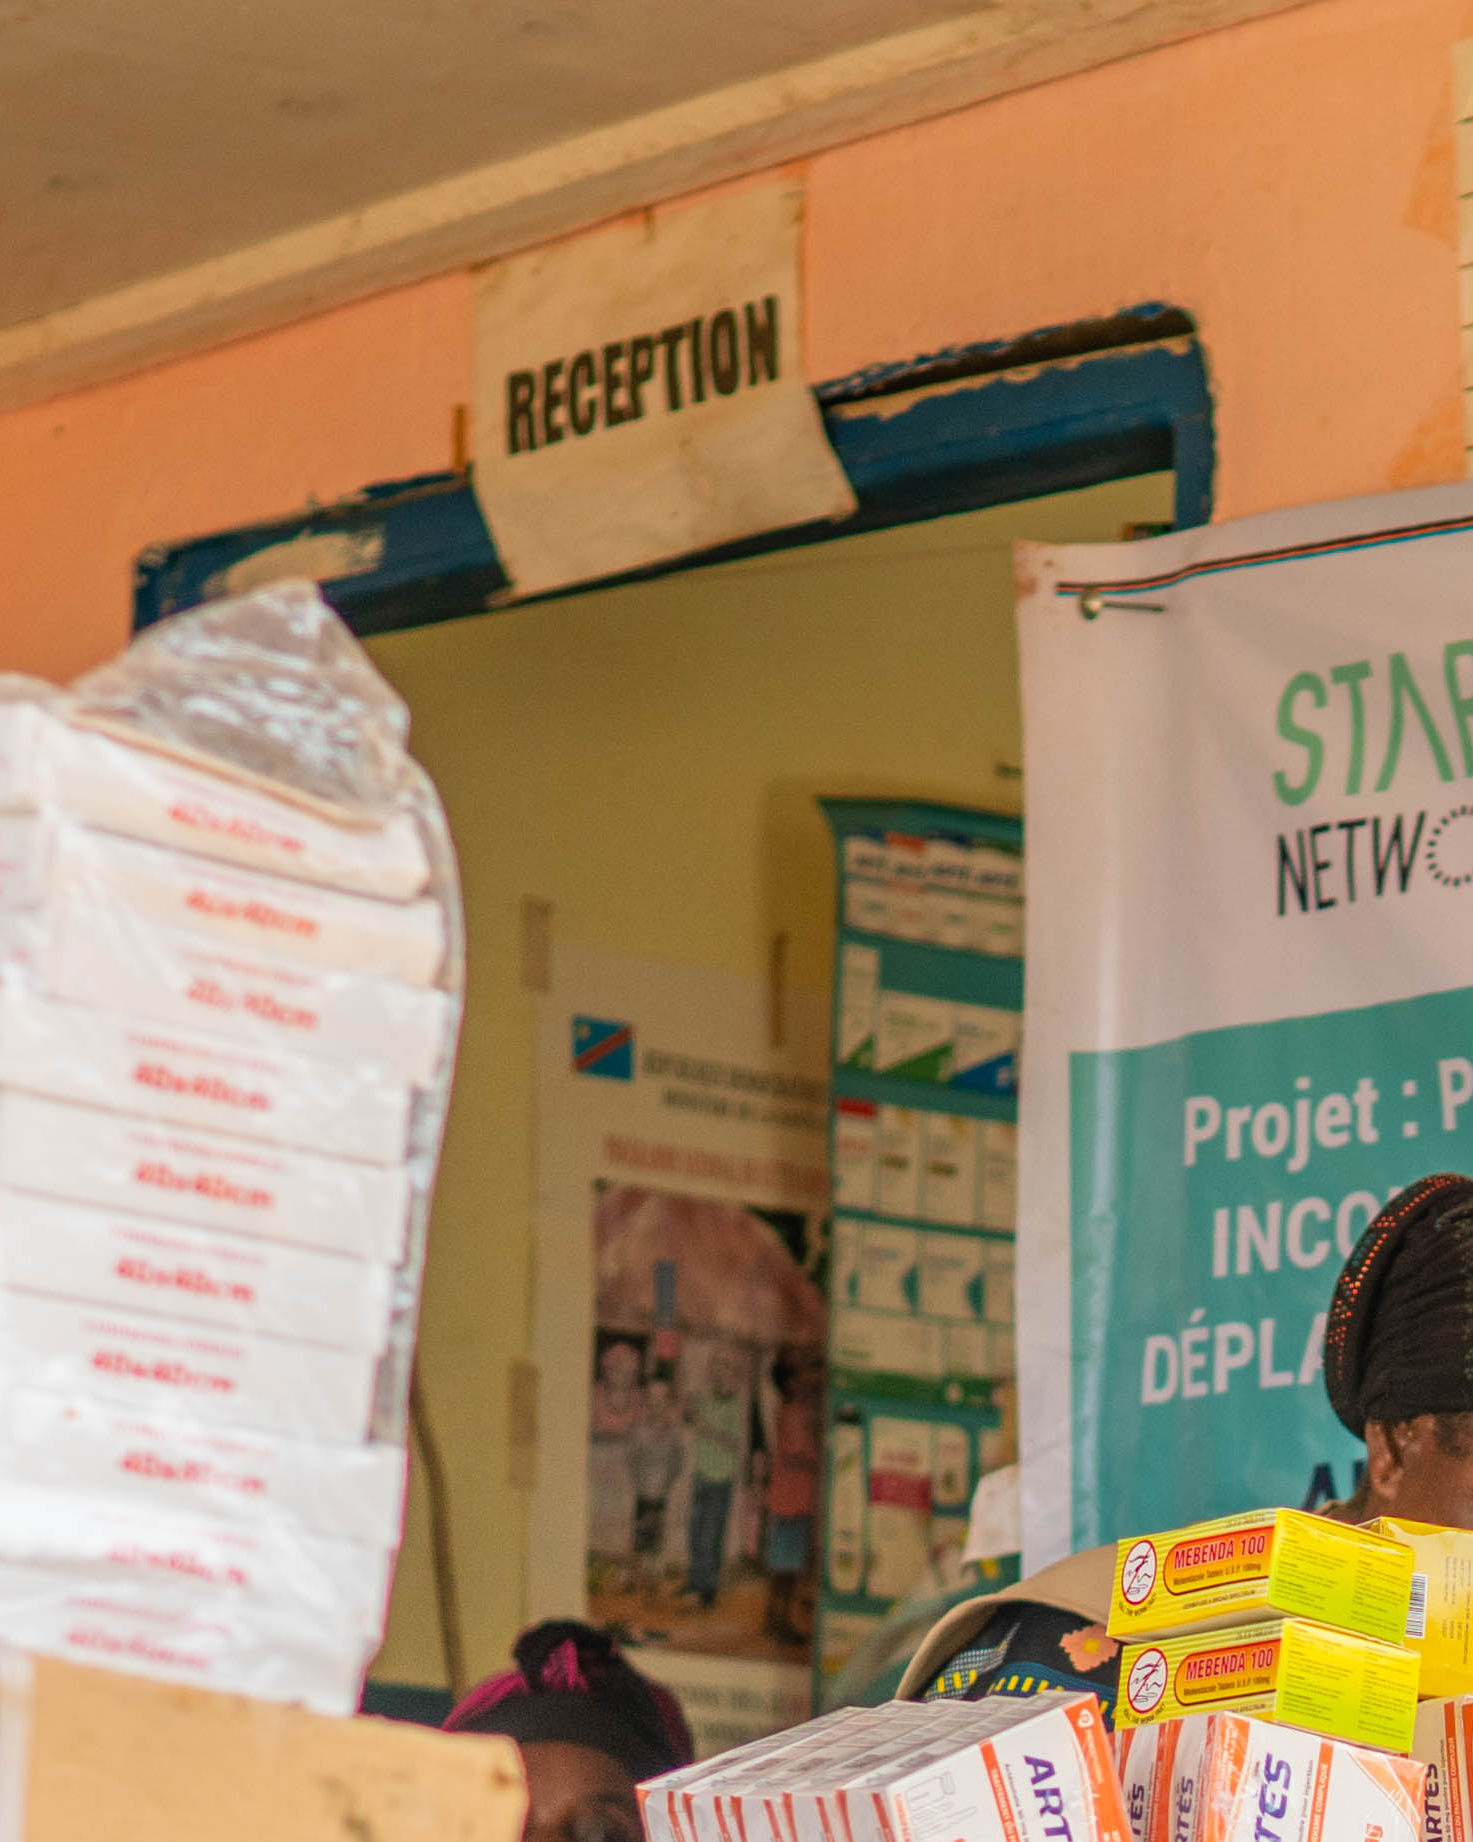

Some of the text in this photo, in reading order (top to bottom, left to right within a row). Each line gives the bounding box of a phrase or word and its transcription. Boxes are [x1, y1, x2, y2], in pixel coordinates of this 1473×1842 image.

[506, 295, 779, 457] RECEPTION
[1183, 1075, 1379, 1172] Projet
[1140, 1308, 1327, 1406] DÉPLA
[1174, 1535, 1266, 1570] MEBENDA 100
[1185, 1648, 1274, 1681] MEBENDA 100
